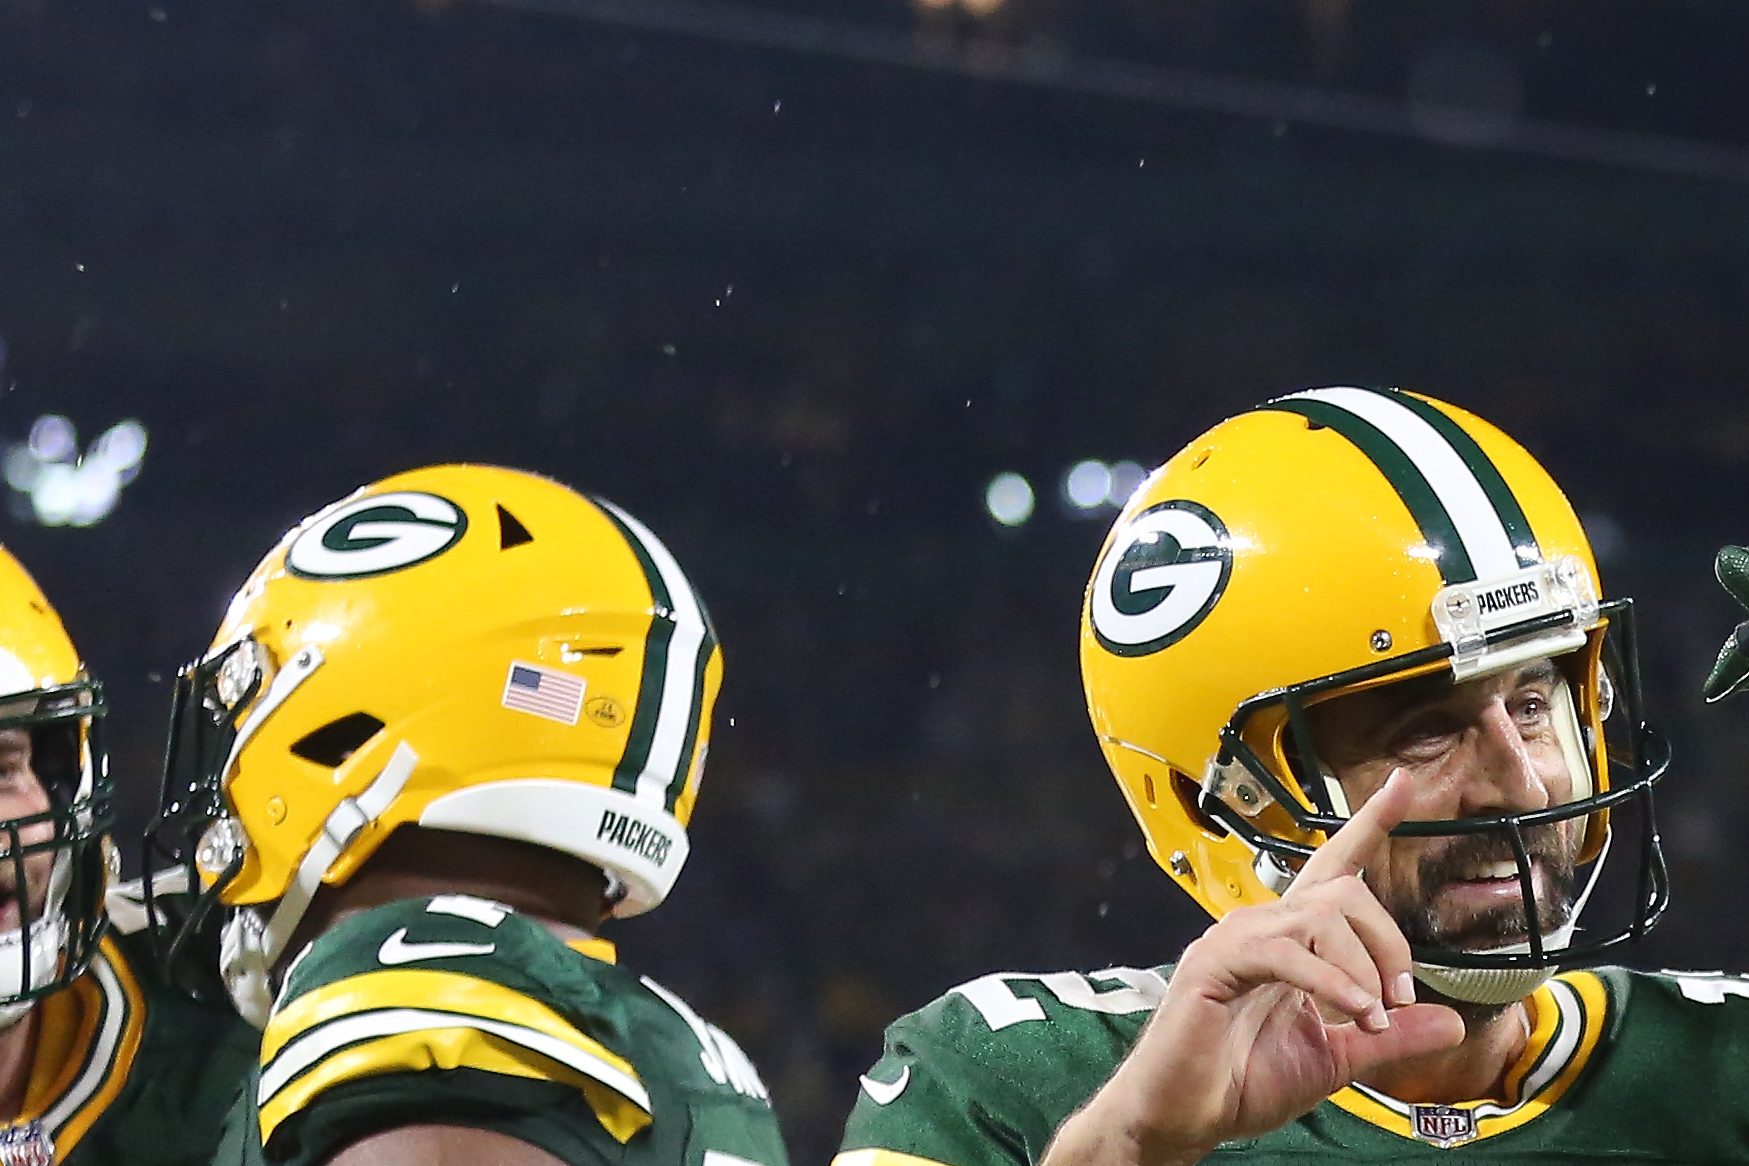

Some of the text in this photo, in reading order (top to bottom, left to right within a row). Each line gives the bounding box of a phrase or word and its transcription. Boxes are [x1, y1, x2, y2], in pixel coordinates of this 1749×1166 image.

[1476, 580, 1540, 616] PACKERS
[596, 809, 673, 868] PACKERS
[1422, 1115, 1468, 1137] NFL
